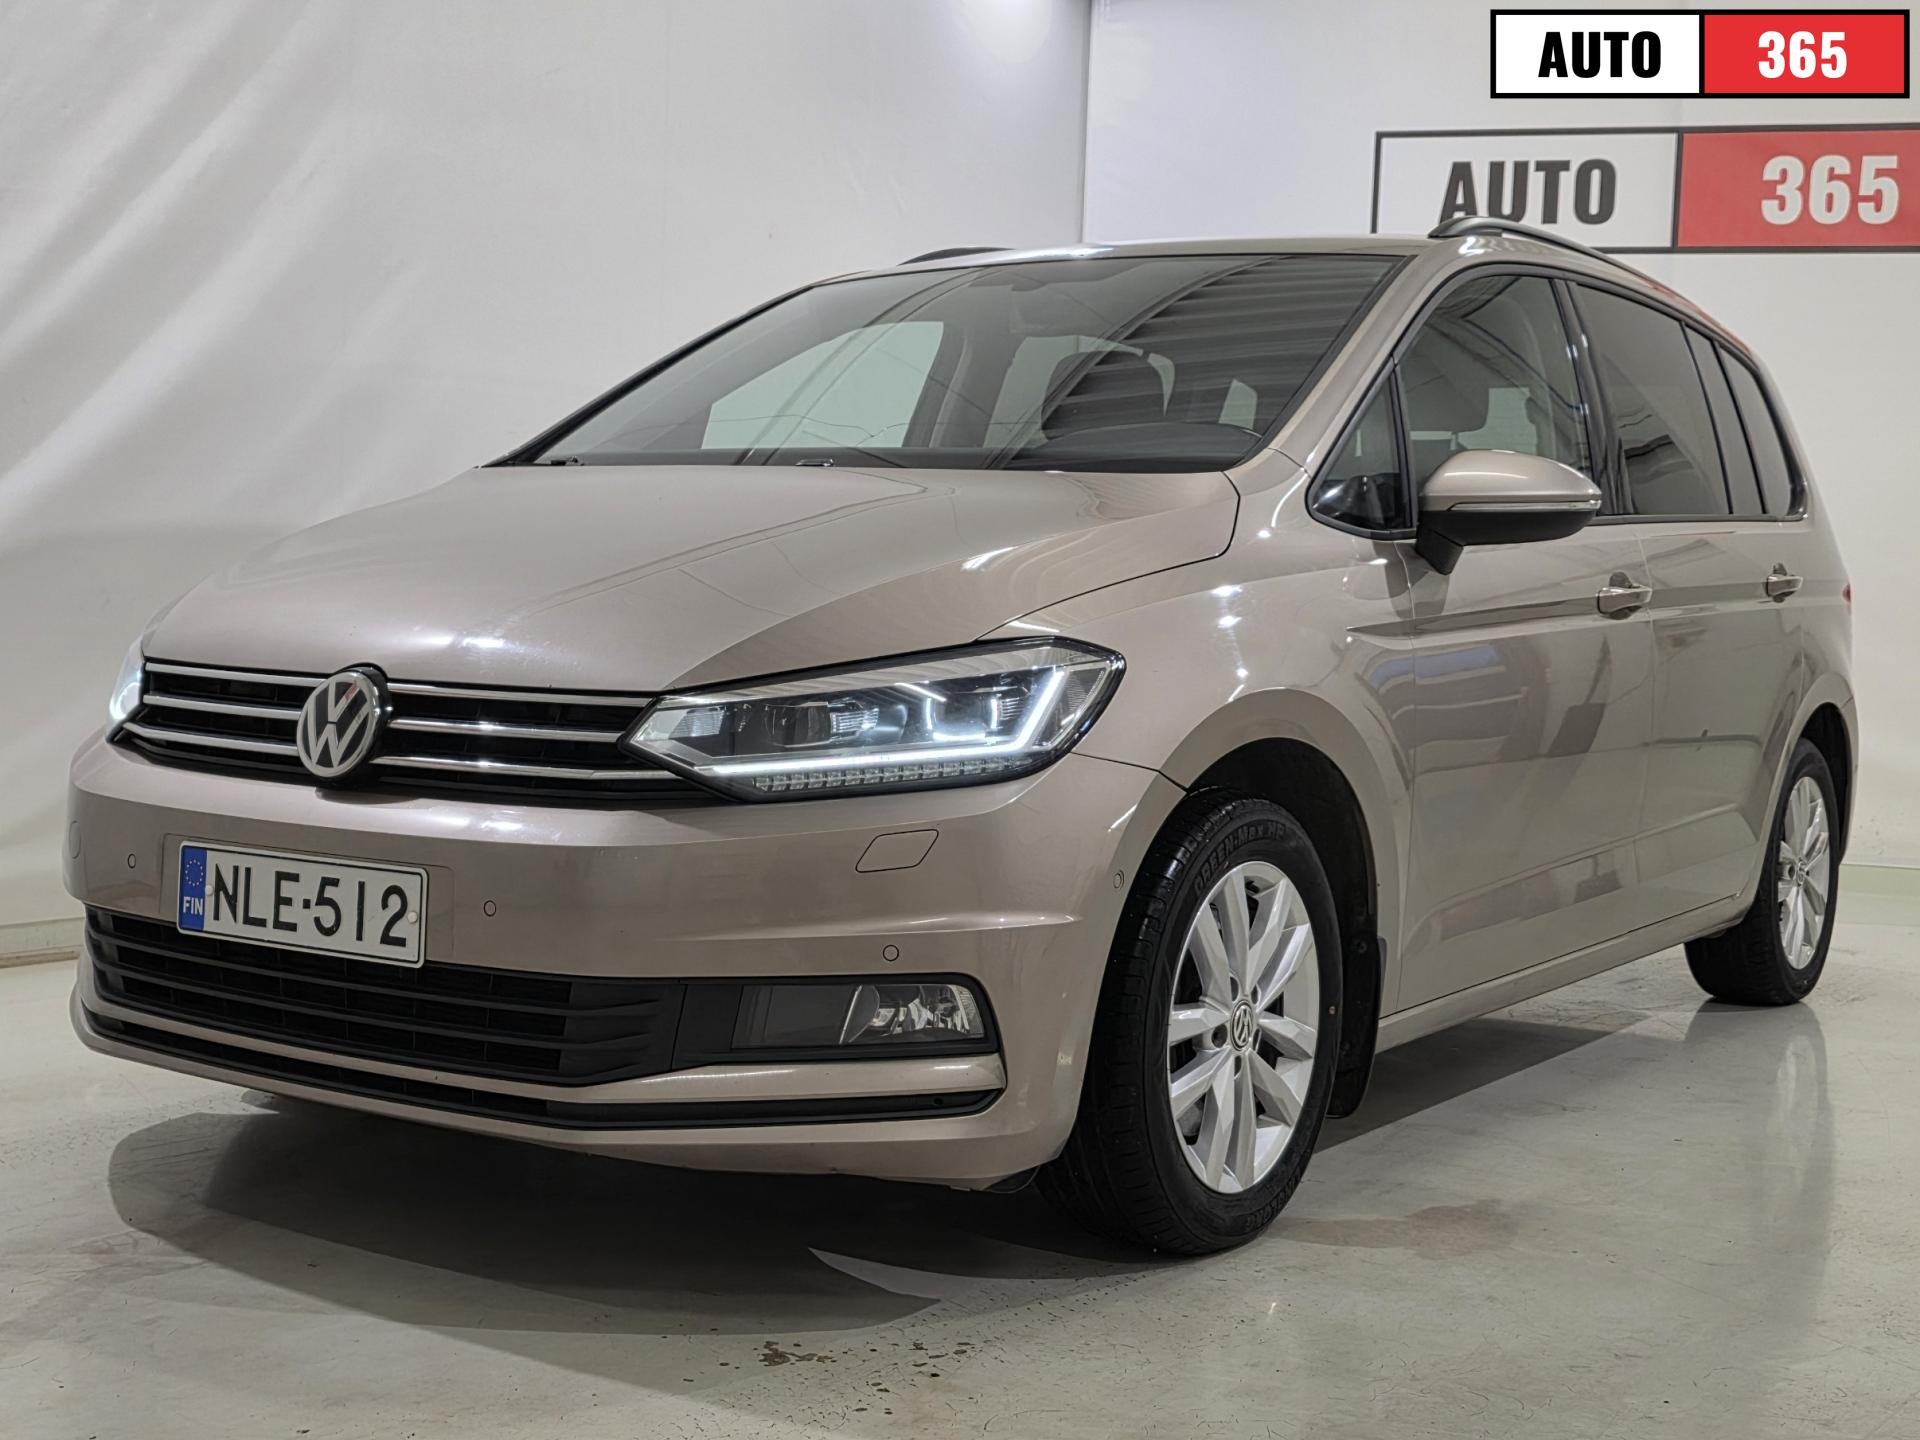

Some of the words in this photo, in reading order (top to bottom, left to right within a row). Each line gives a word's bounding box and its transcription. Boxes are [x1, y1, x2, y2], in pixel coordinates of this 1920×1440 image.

[1440, 158, 1617, 225] AUTO
[1761, 155, 1899, 225] 365
[302, 676, 374, 773] VW
[183, 895, 204, 915] FIN
[213, 863, 408, 948] NLE-512
